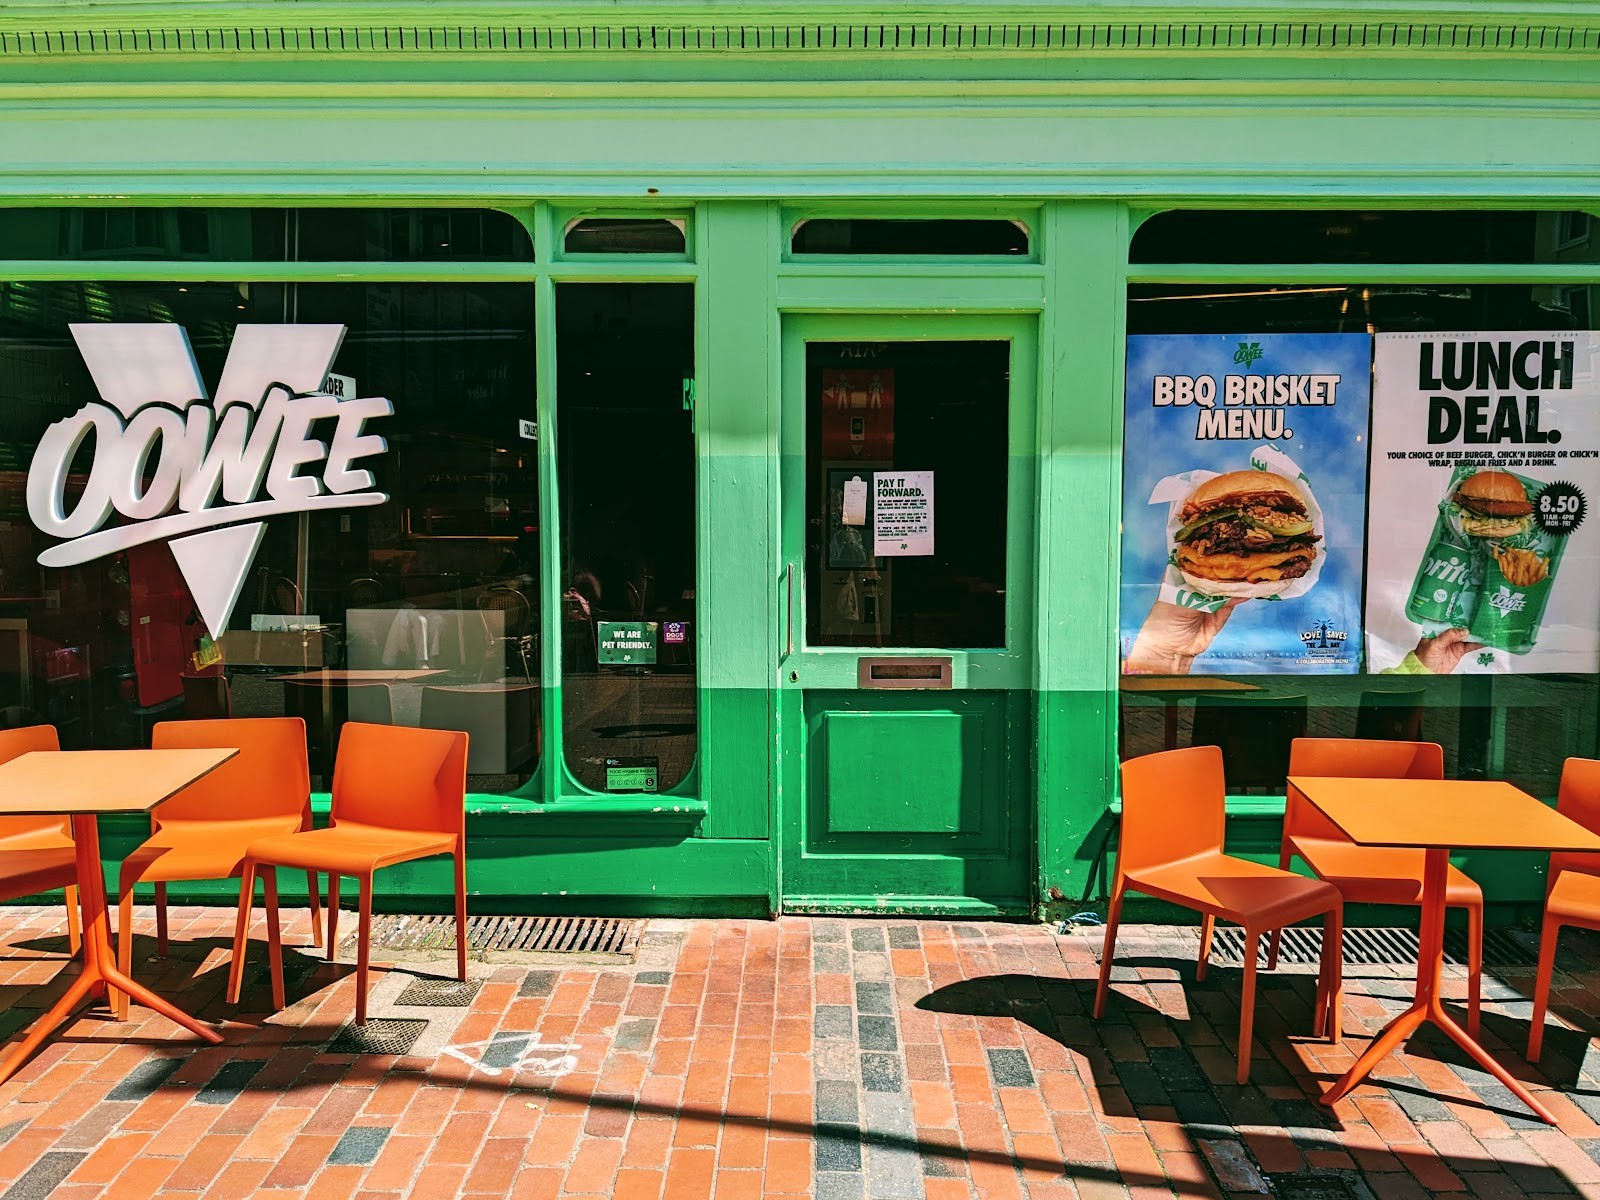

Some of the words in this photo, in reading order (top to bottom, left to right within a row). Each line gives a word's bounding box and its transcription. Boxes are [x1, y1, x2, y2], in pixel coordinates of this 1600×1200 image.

[1419, 340, 1574, 391] LUNCH
[1153, 374, 1217, 409] BBQ
[1224, 374, 1341, 406] BRISKET
[1195, 408, 1294, 440] MENU.
[1427, 396, 1562, 445] DEAL.
[1446, 451, 1463, 459] BEEF
[1464, 451, 1495, 459] BURGER,
[1569, 450, 1599, 458] CHICK'N
[26, 382, 394, 540] OOWEE
[1428, 460, 1452, 468] WRAP,
[877, 478, 895, 488] PAY
[897, 478, 905, 488] IT
[877, 488, 924, 497] FORWARD.
[1540, 495, 1580, 513] 8.50
[613, 630, 625, 638] WE
[626, 630, 641, 638] ARE
[1300, 630, 1321, 642] LOVE
[1326, 630, 1348, 641] SAVES
[602, 641, 615, 649] PET
[616, 641, 653, 649] FRIENDLY.
[647, 778, 653, 786] 5
